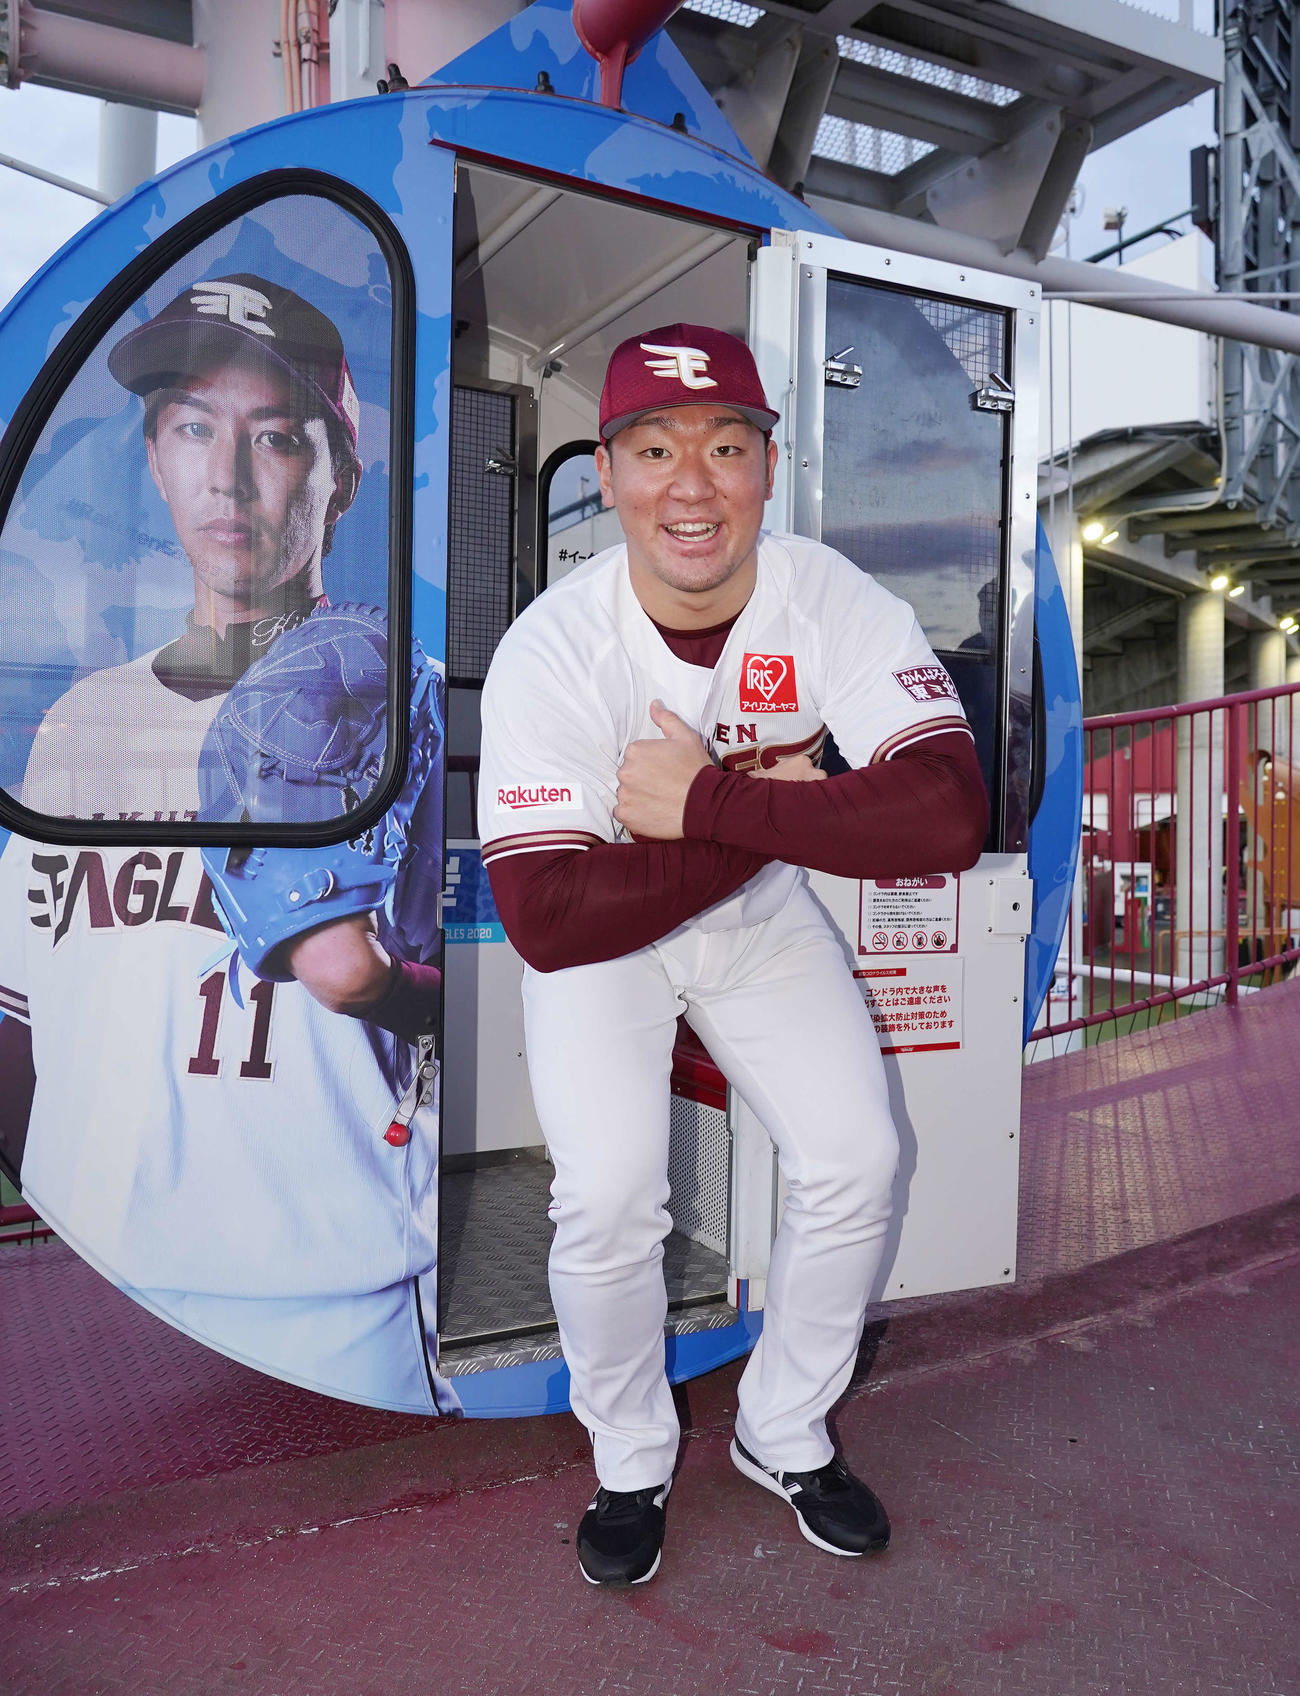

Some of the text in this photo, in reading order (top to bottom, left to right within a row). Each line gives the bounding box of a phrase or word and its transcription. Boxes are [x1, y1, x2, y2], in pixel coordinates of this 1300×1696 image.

[741, 700, 797, 711] アイリスオーヤマ
[497, 784, 572, 806] Rakuten
[895, 876, 928, 887] おねがい
[467, 928, 492, 939] 2020
[865, 984, 947, 998] ゴンドラ内で大きな声を
[870, 1010, 947, 1024] 染拡大防止対策のため
[187, 971, 274, 1080] 11
